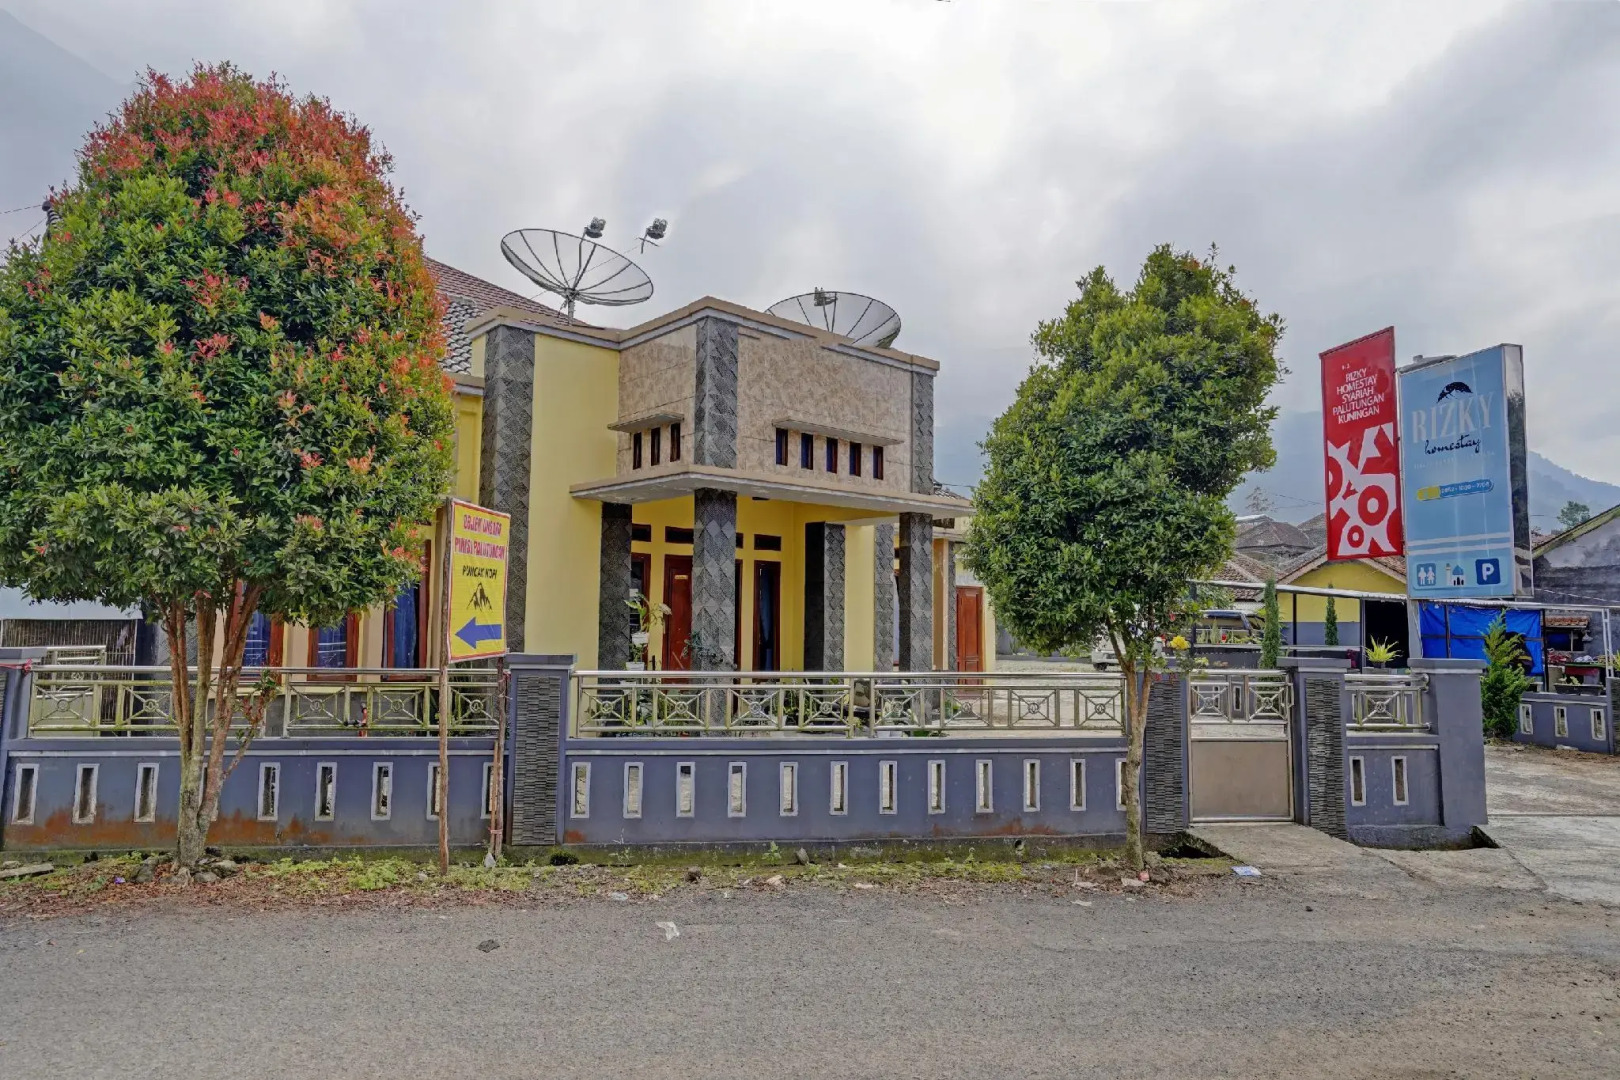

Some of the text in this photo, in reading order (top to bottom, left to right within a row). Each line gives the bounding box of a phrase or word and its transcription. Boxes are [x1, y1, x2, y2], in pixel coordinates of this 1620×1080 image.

[1337, 374, 1377, 395] HOMESTAY
[1346, 368, 1367, 383] RIZKY
[1333, 393, 1384, 416] PALUTUNGAN
[1342, 386, 1374, 404] SYARIAH
[1338, 405, 1380, 424] KUNINGAN
[1412, 392, 1494, 443] RIZKY
[1424, 434, 1481, 455] homestay
